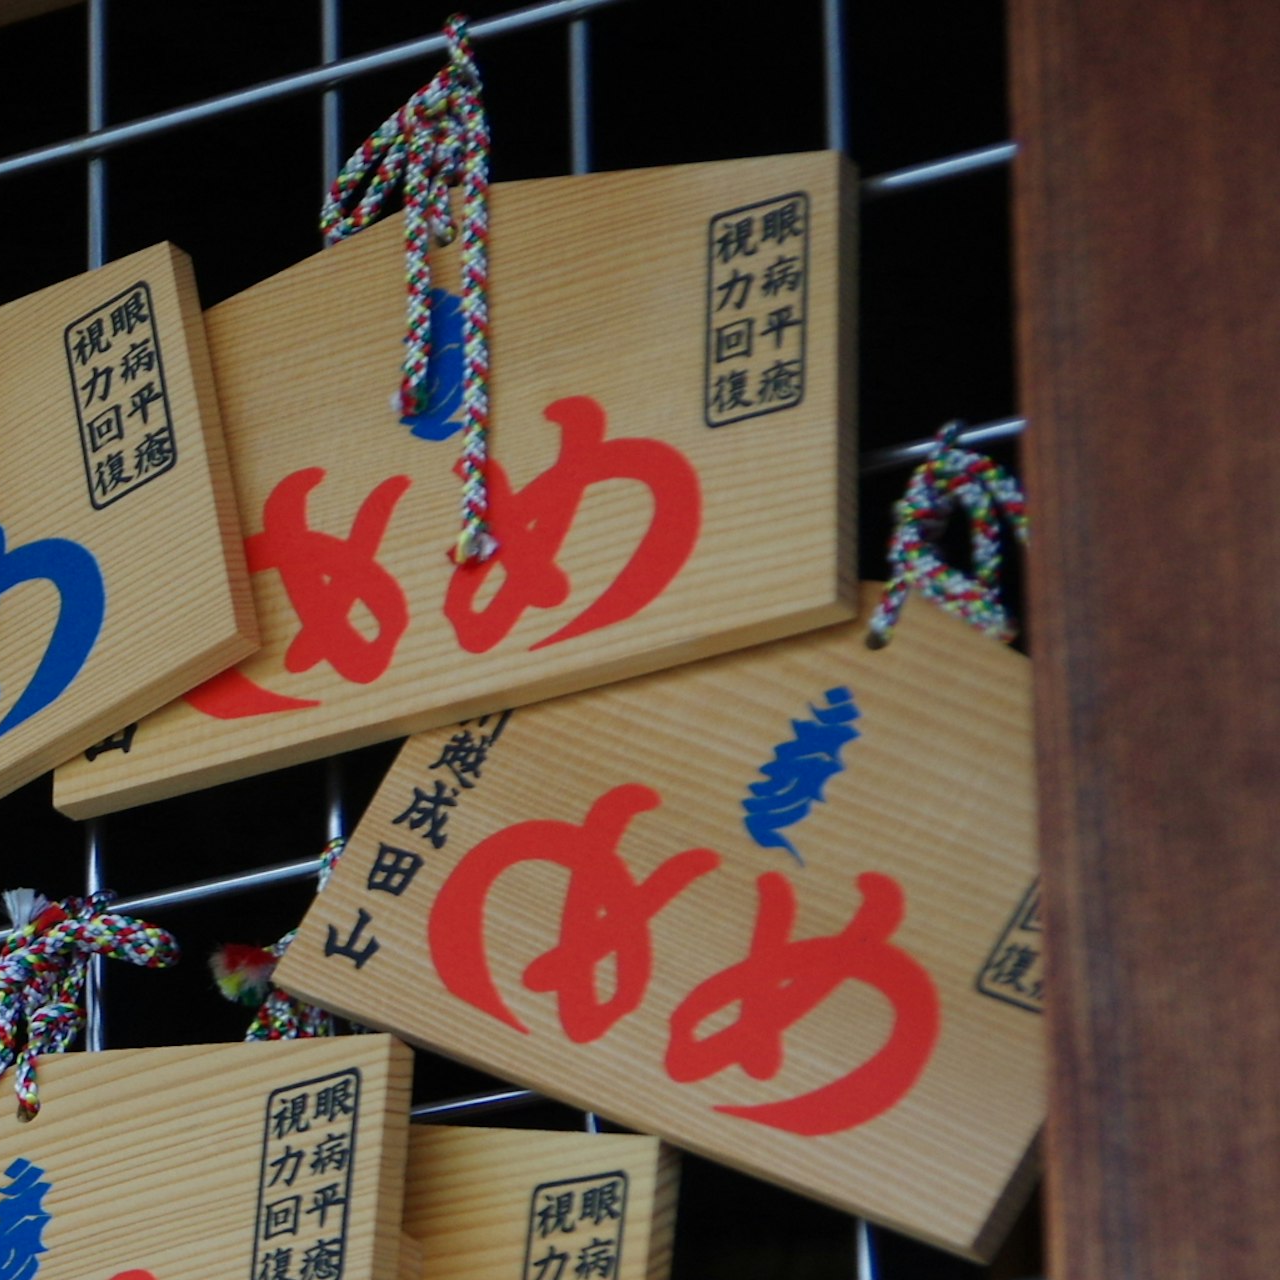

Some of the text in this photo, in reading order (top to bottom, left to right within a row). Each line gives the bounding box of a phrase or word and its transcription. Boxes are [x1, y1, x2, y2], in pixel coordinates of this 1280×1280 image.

[111, 294, 175, 474] 眼病平癒
[712, 218, 758, 412] 視力回復
[757, 199, 803, 405] 眼病平癒
[71, 324, 131, 497] 視力回復
[428, 782, 941, 1137] めめ
